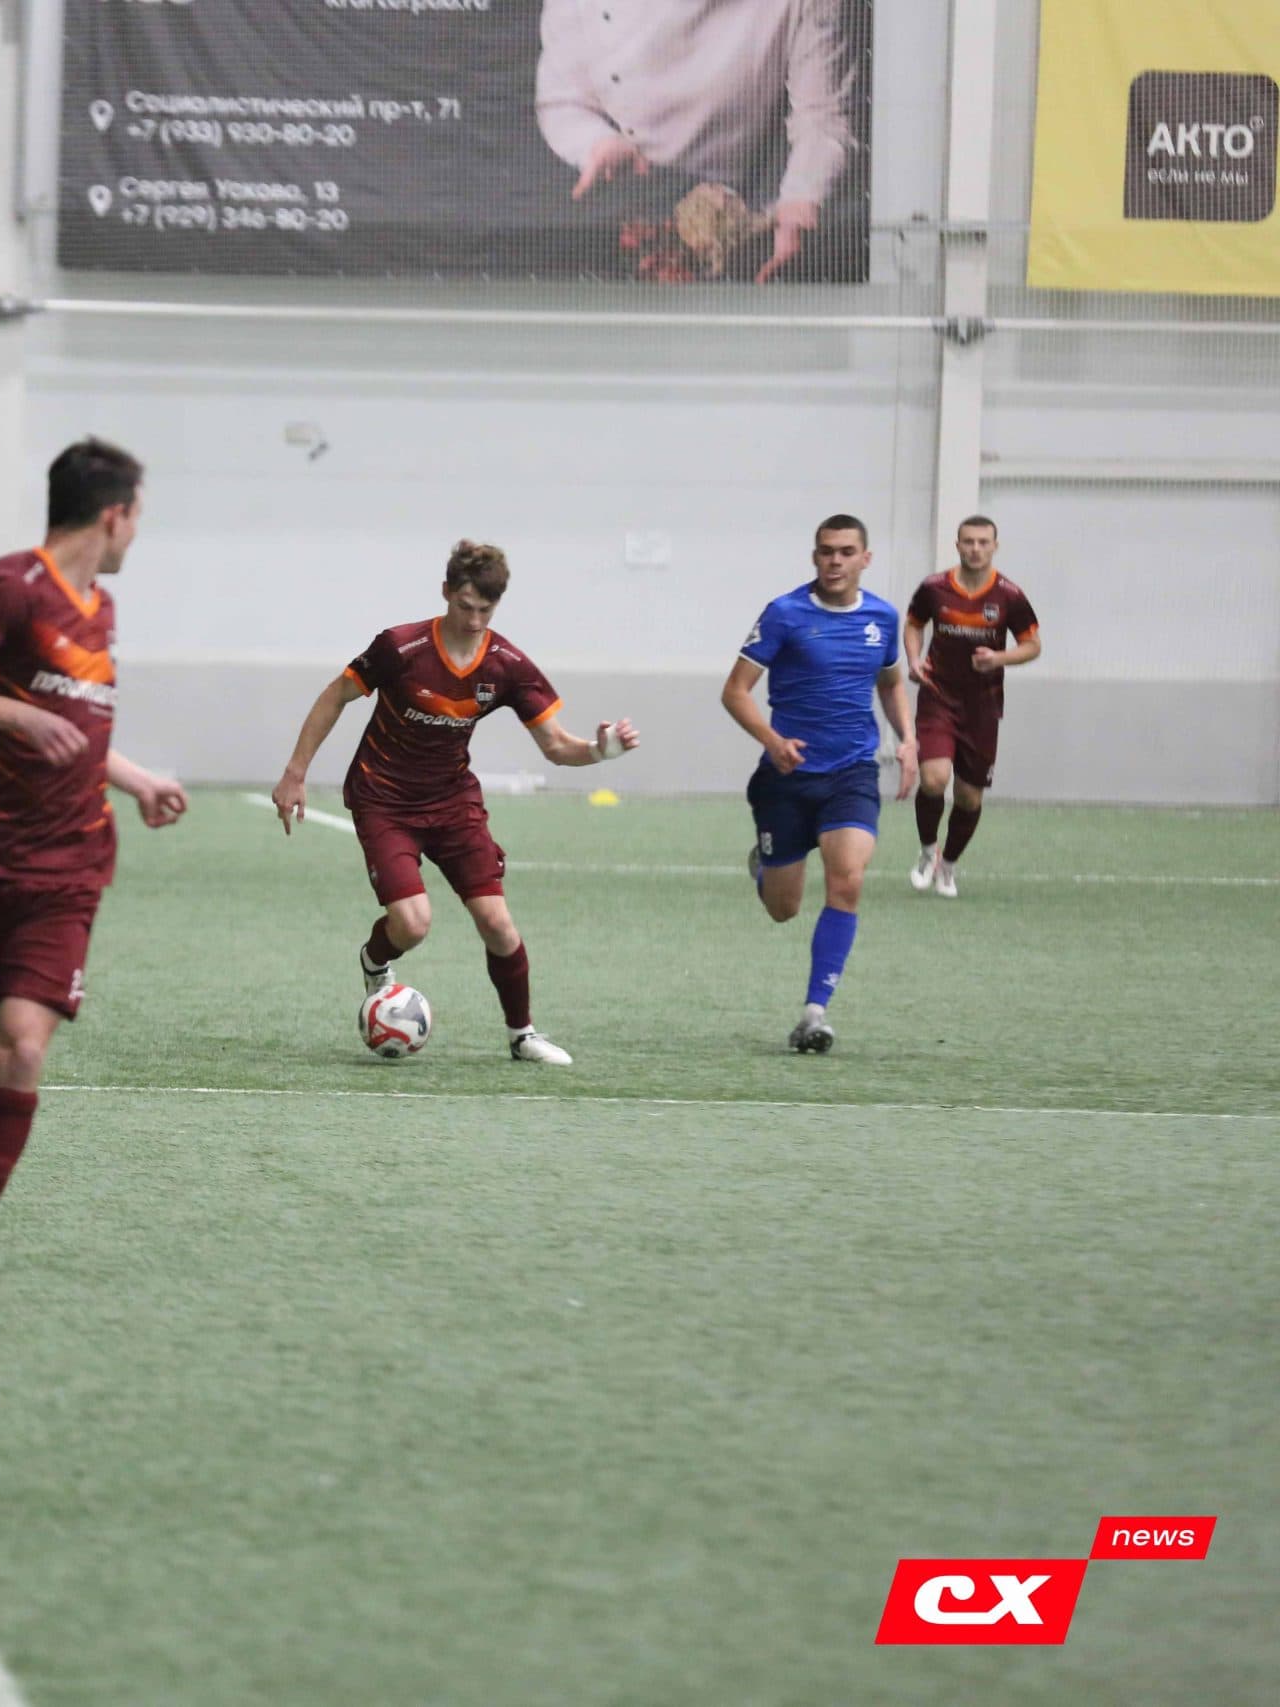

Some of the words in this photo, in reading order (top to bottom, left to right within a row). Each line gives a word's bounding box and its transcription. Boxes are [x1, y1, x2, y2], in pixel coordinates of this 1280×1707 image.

[126, 90, 366, 119] Социалистический
[126, 118, 156, 141] +7
[122, 202, 150, 225] +7
